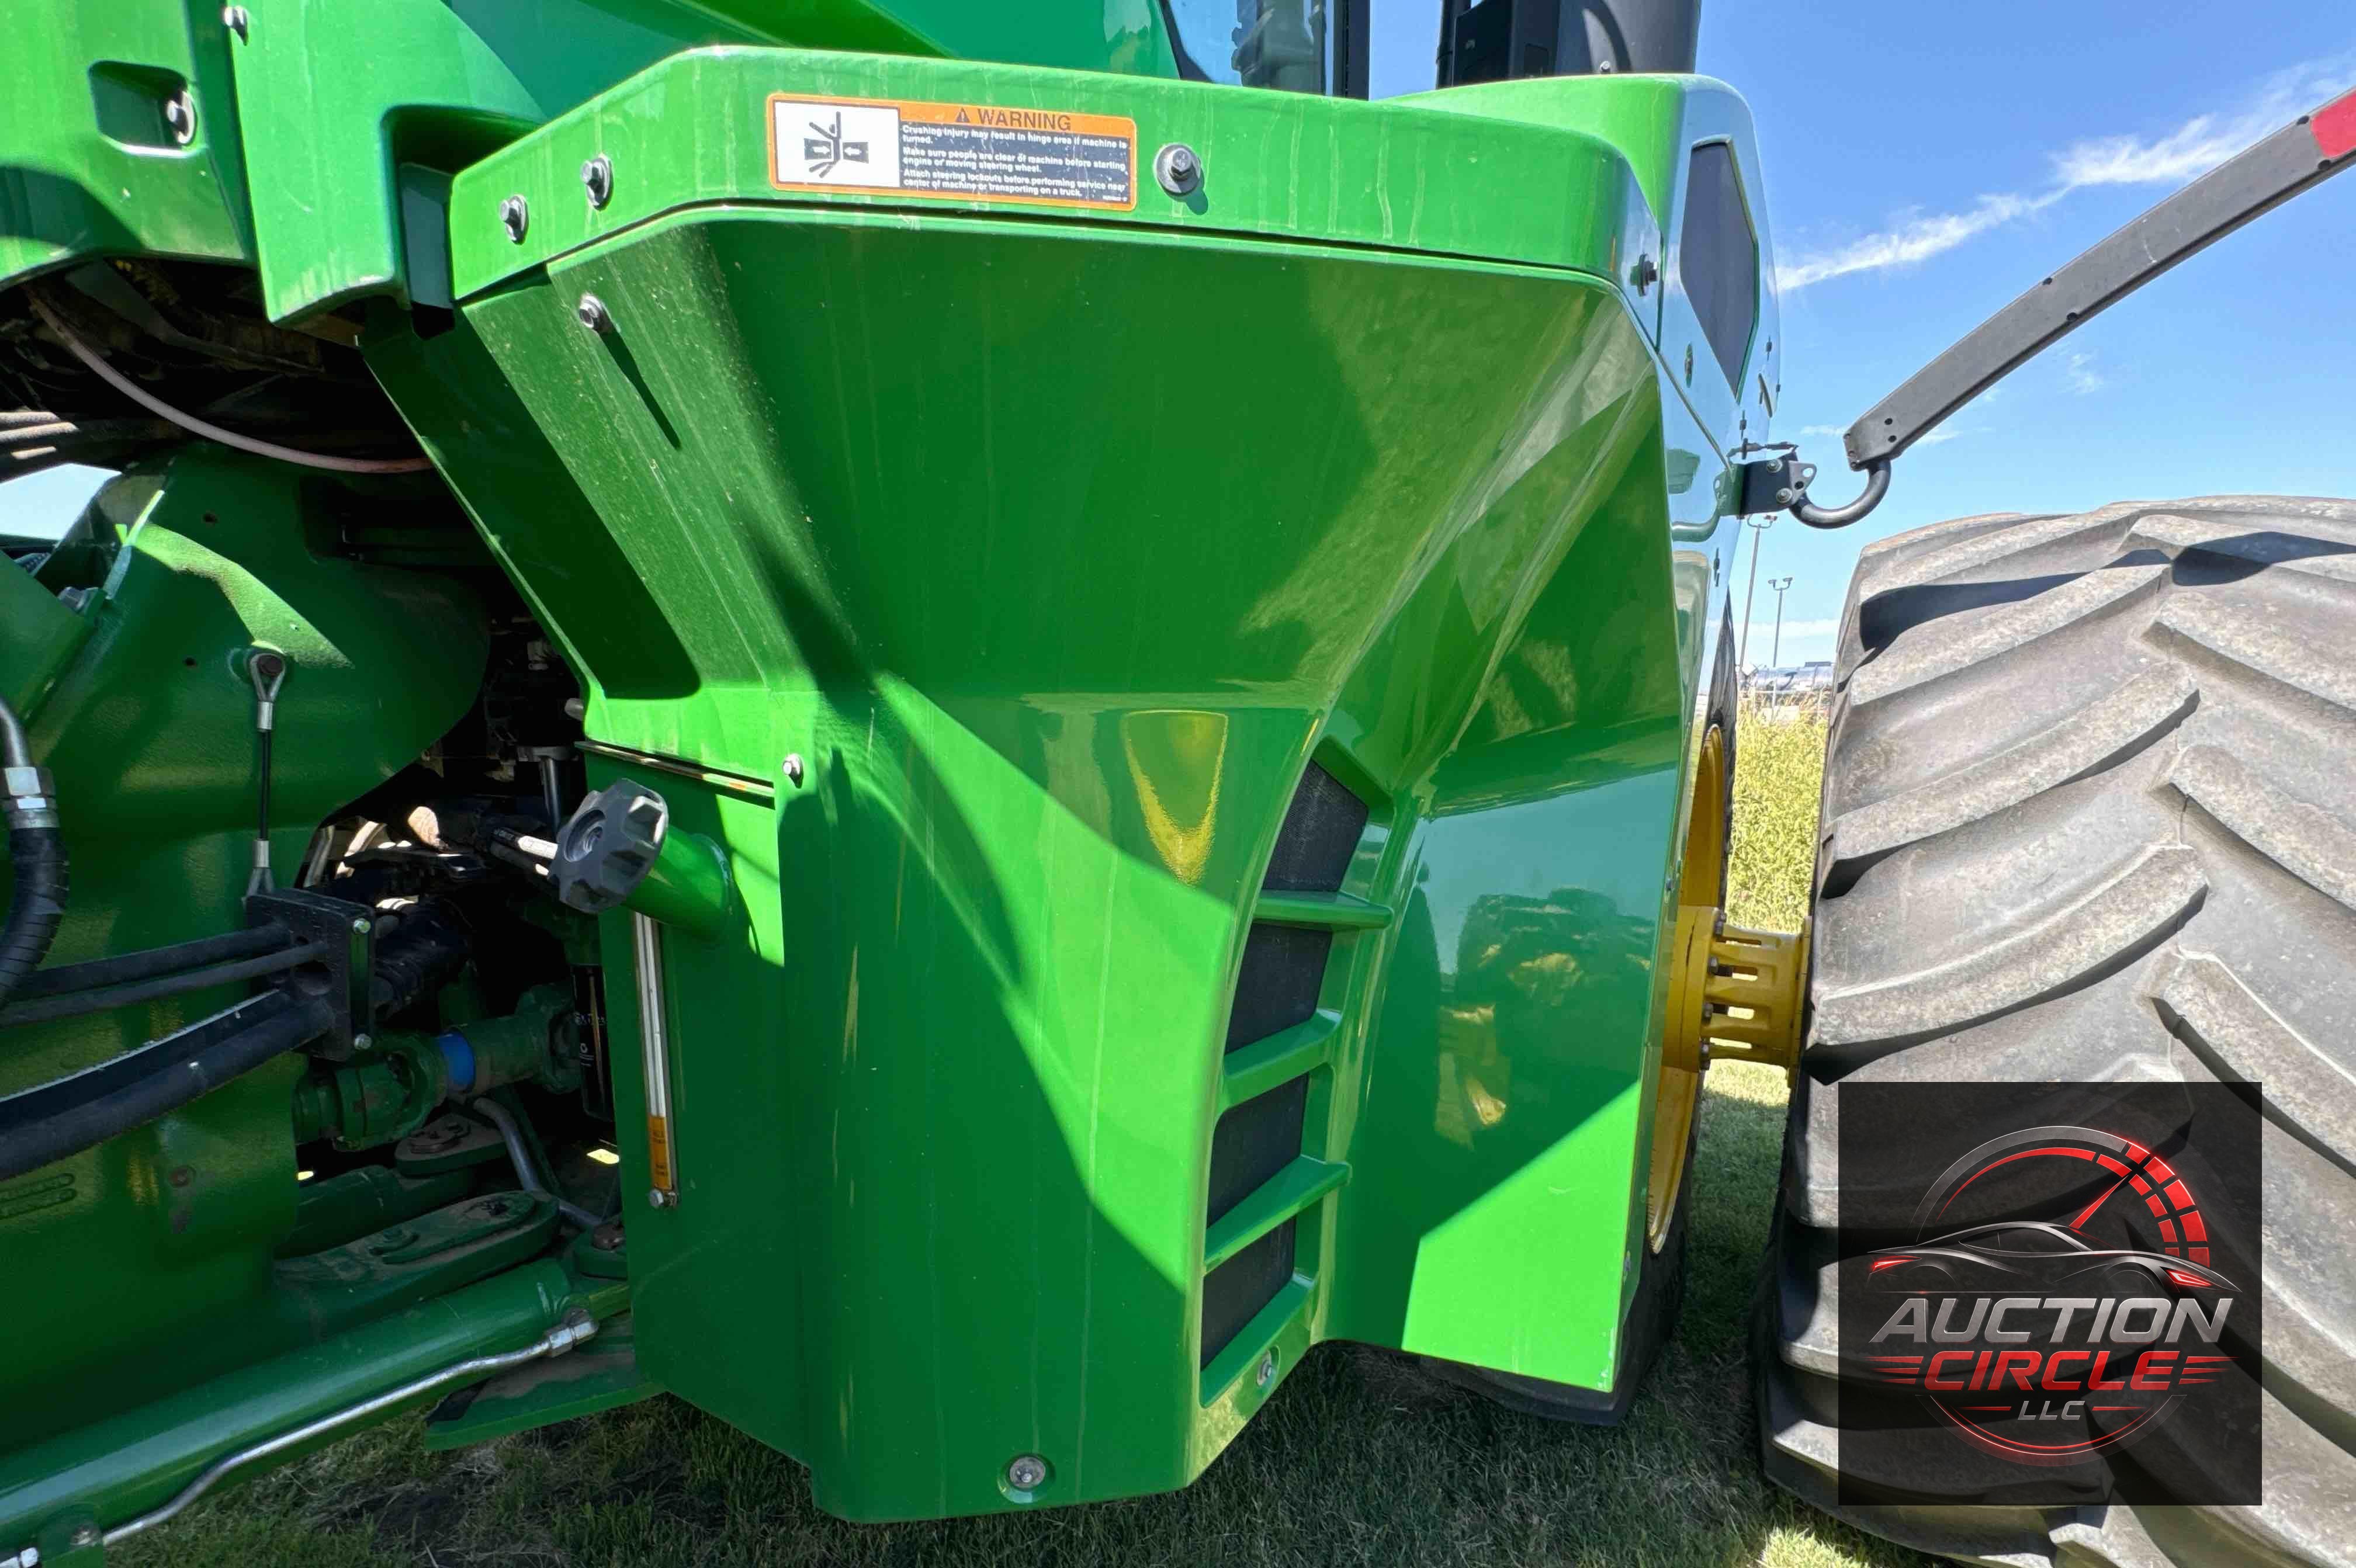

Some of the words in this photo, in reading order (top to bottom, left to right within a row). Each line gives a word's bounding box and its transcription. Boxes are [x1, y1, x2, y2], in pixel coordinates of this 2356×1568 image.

[978, 107, 1072, 131] WARNING
[902, 124, 943, 137] Crushing
[944, 127, 969, 139] injury
[971, 130, 989, 140] may
[990, 131, 1016, 140] result
[1017, 133, 1025, 141] in
[1027, 132, 1051, 145] hinge
[1054, 136, 1072, 145] area
[1074, 136, 1080, 145] if
[1082, 137, 1118, 148] machine
[1119, 140, 1127, 149] is
[902, 134, 933, 144] turned.
[903, 146, 926, 156] Make
[927, 150, 947, 158] sure
[948, 150, 978, 161] people
[995, 152, 1016, 161] clear
[1017, 153, 1027, 162] of
[1028, 155, 1063, 165] machine
[1065, 158, 1092, 168] before
[1093, 160, 1126, 172] starting
[903, 157, 933, 167] engine
[945, 159, 977, 170] moving
[978, 161, 1013, 172] steering
[1014, 164, 1042, 173] wheel.
[903, 169, 931, 178] Attach
[933, 170, 966, 181] steering
[967, 172, 1002, 183] lockouts
[1003, 174, 1030, 184] before
[1031, 177, 1076, 189] performing
[1077, 179, 1106, 190] service
[1107, 183, 1127, 192] near
[903, 178, 930, 188] center
[931, 179, 941, 188] of
[942, 180, 976, 190] machine
[988, 183, 1039, 195] transporting
[1059, 187, 1082, 197] truck.
